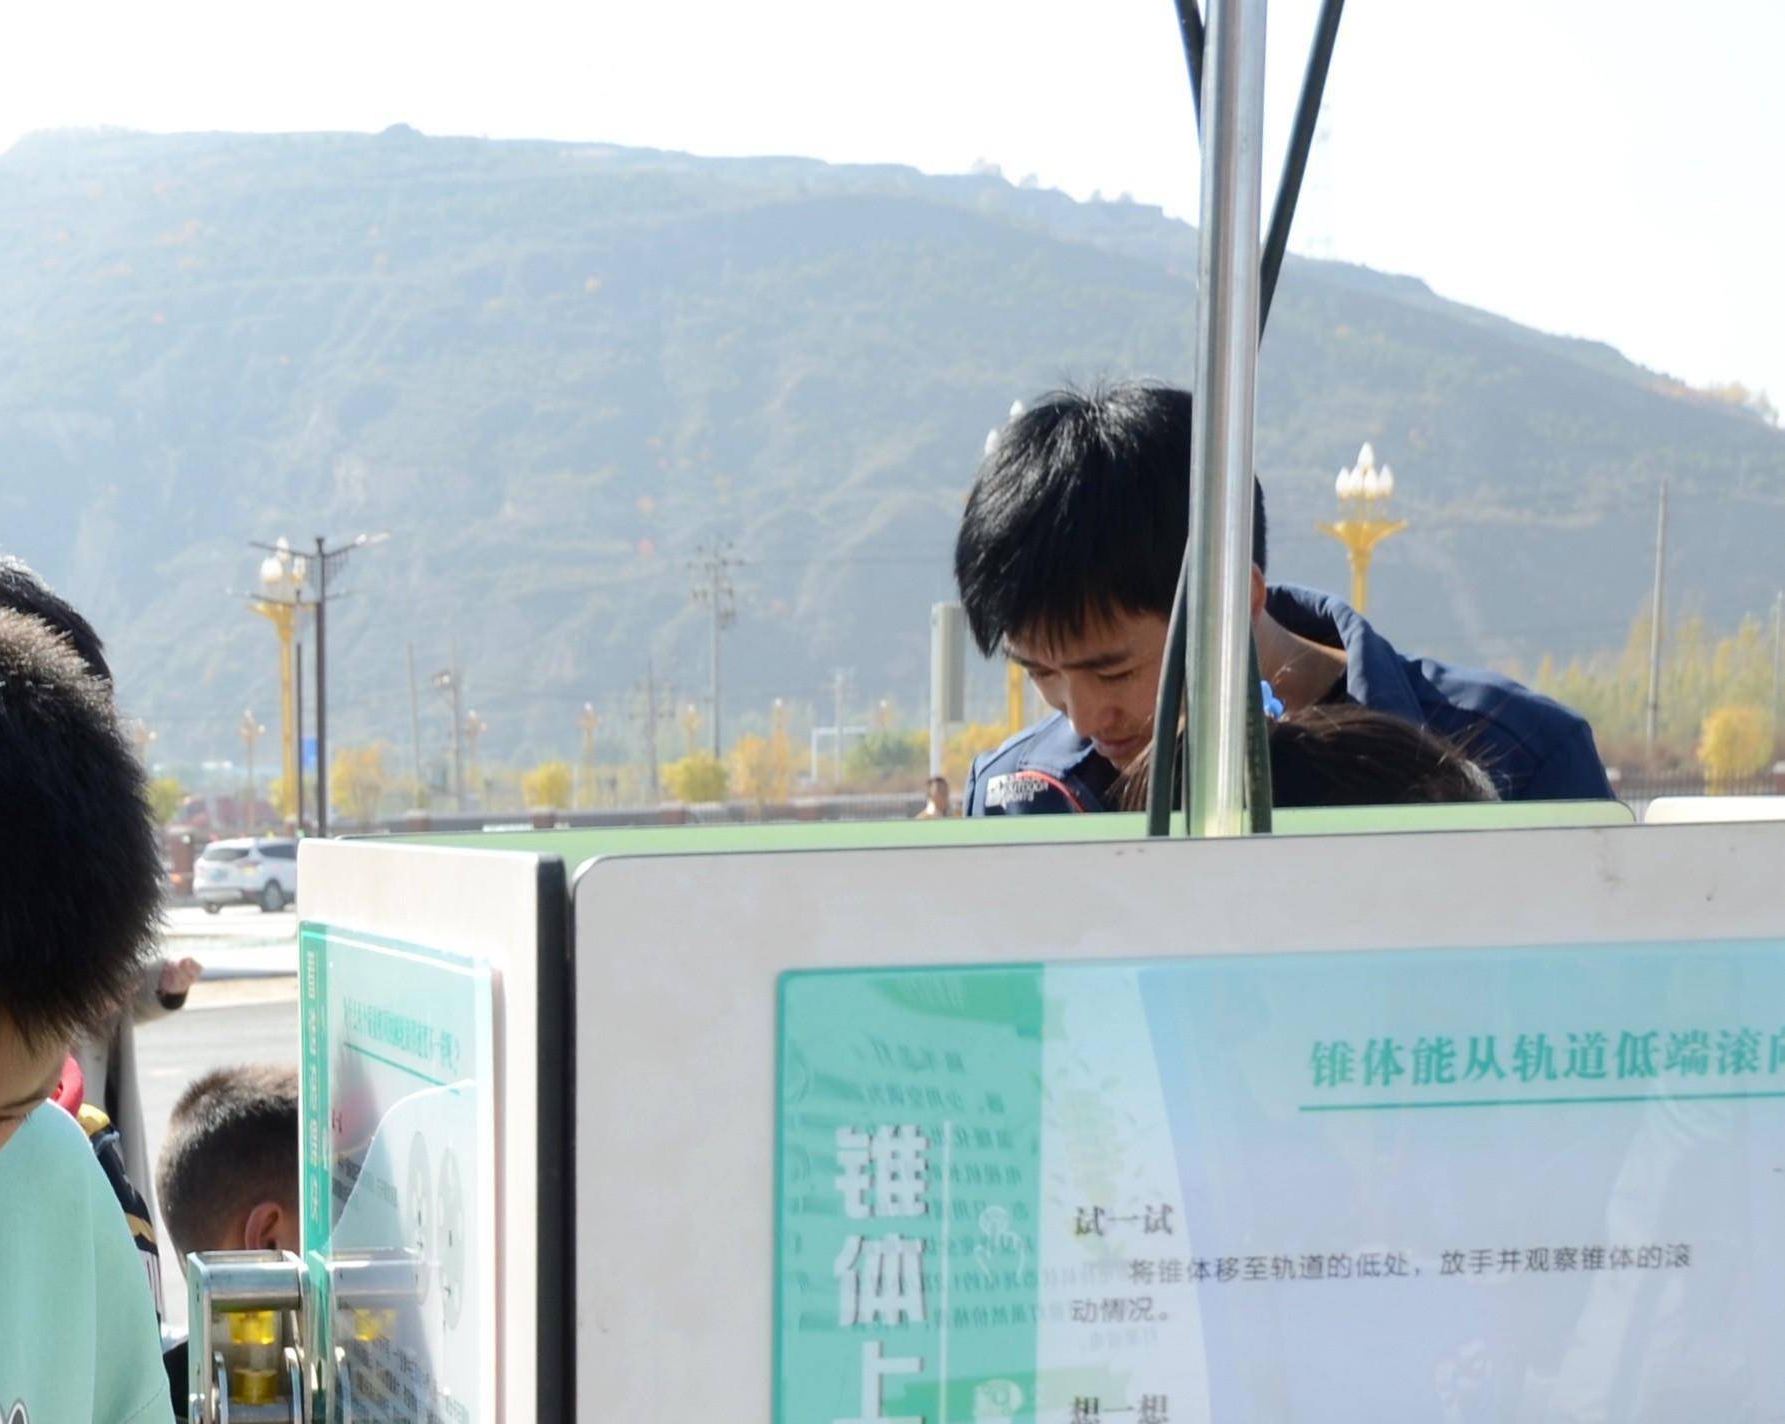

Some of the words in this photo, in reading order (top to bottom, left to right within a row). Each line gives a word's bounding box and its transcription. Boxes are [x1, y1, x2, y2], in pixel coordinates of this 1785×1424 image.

[1075, 1203, 1174, 1237] 试一试
[1128, 1243, 1692, 1286] 将锥体移至轨道的低处，放手并观察锥体的滚
[1070, 1297, 1169, 1324] 动情况。
